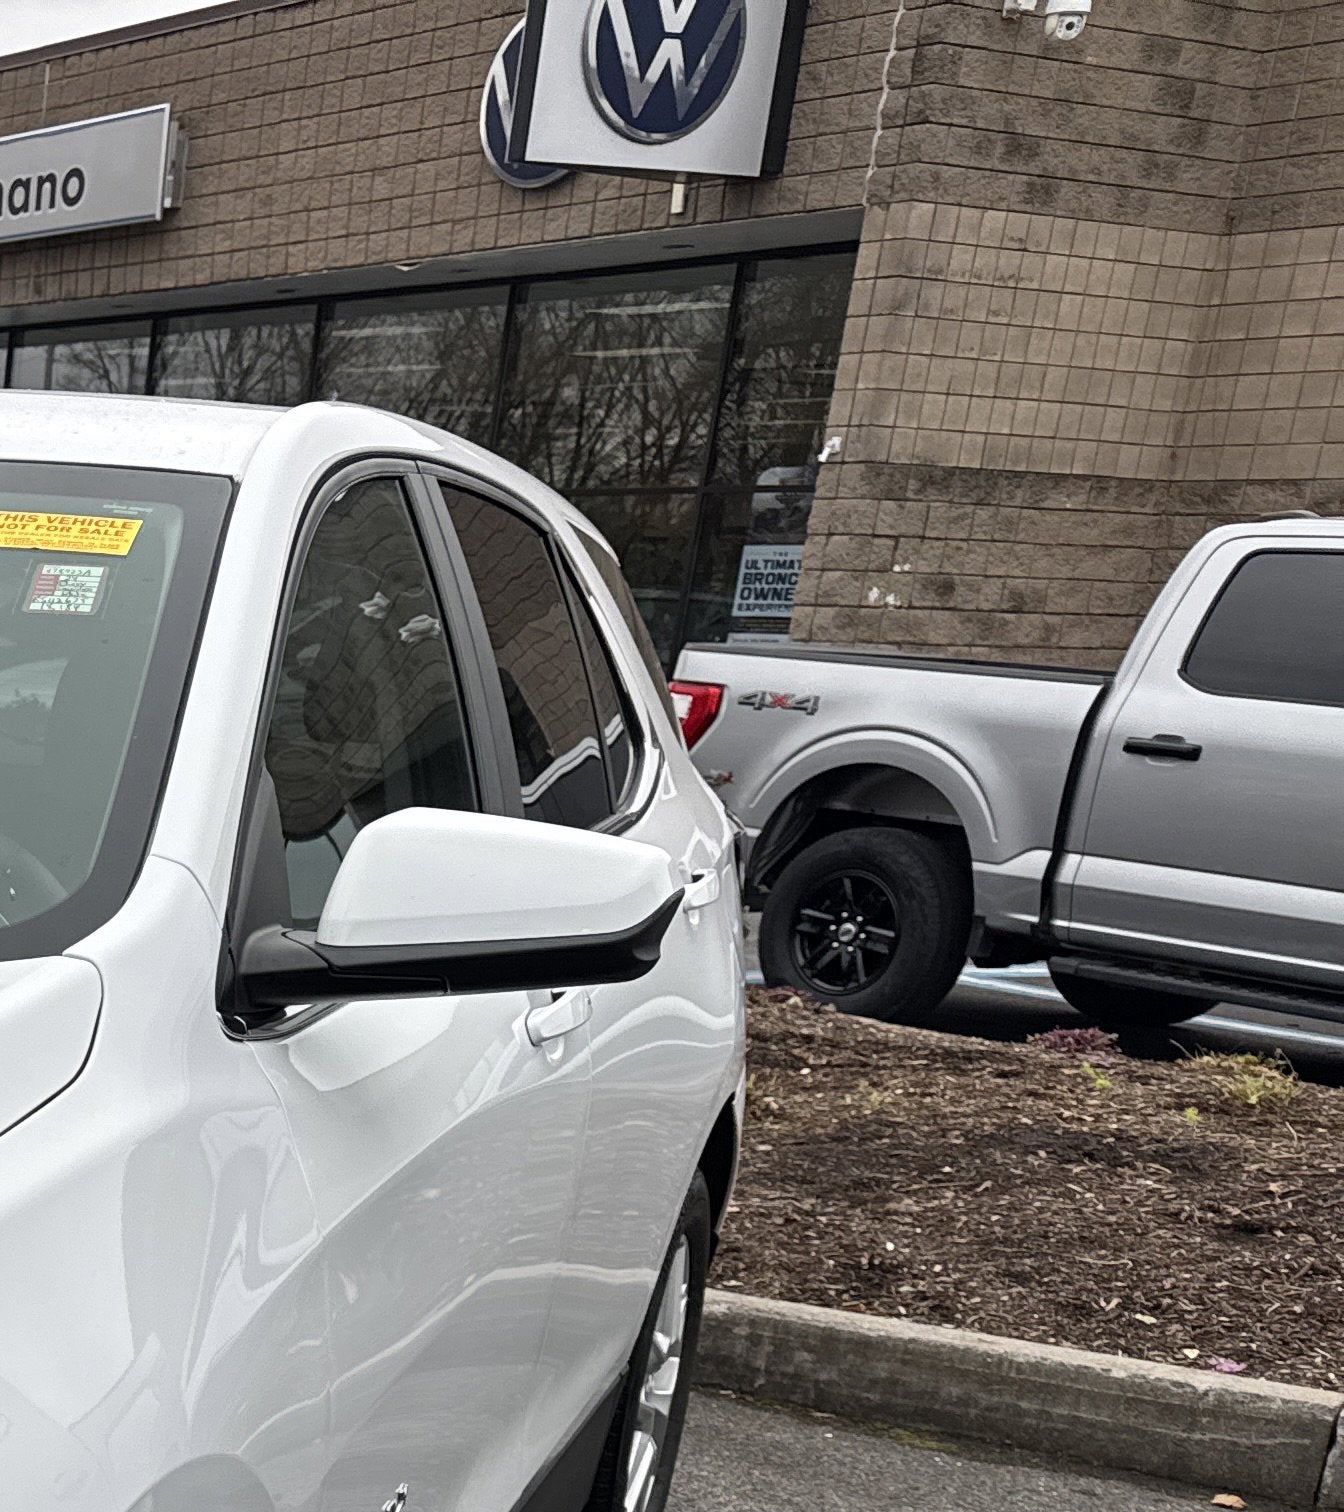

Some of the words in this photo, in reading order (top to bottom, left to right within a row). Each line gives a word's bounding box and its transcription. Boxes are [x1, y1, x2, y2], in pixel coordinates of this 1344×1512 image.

[47, 516, 136, 530] VEHICLE
[34, 524, 73, 533] FOR
[78, 528, 127, 537] SALE
[742, 572, 799, 586] BRONC
[740, 587, 796, 602] OWNE
